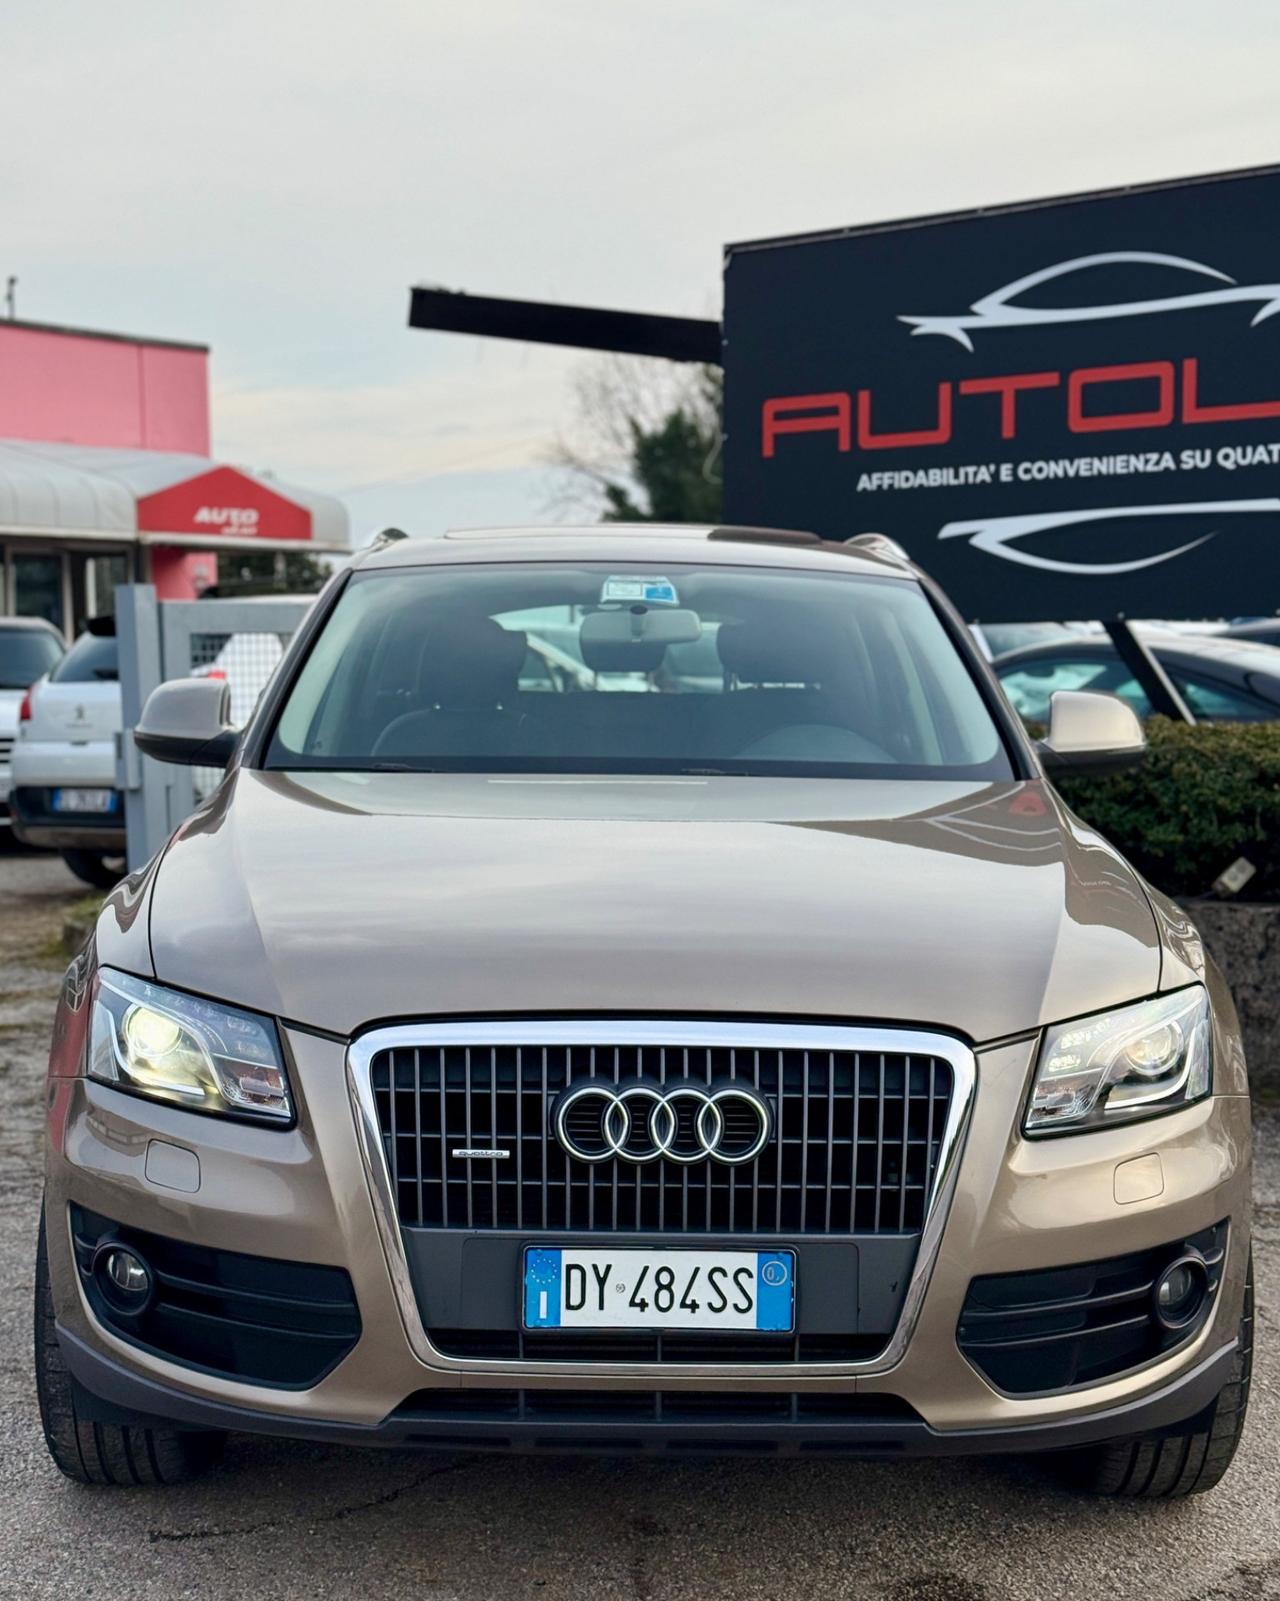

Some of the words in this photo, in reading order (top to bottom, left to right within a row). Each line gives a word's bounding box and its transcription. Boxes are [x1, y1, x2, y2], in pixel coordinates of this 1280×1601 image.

[857, 464, 997, 491] AFFIDABILITA'
[999, 463, 1013, 482] E
[1017, 452, 1176, 481] CONVENIENZA
[1180, 448, 1212, 469] SU
[193, 506, 259, 525] AUTO
[565, 1263, 613, 1311] DY
[628, 1265, 755, 1314] 484SS
